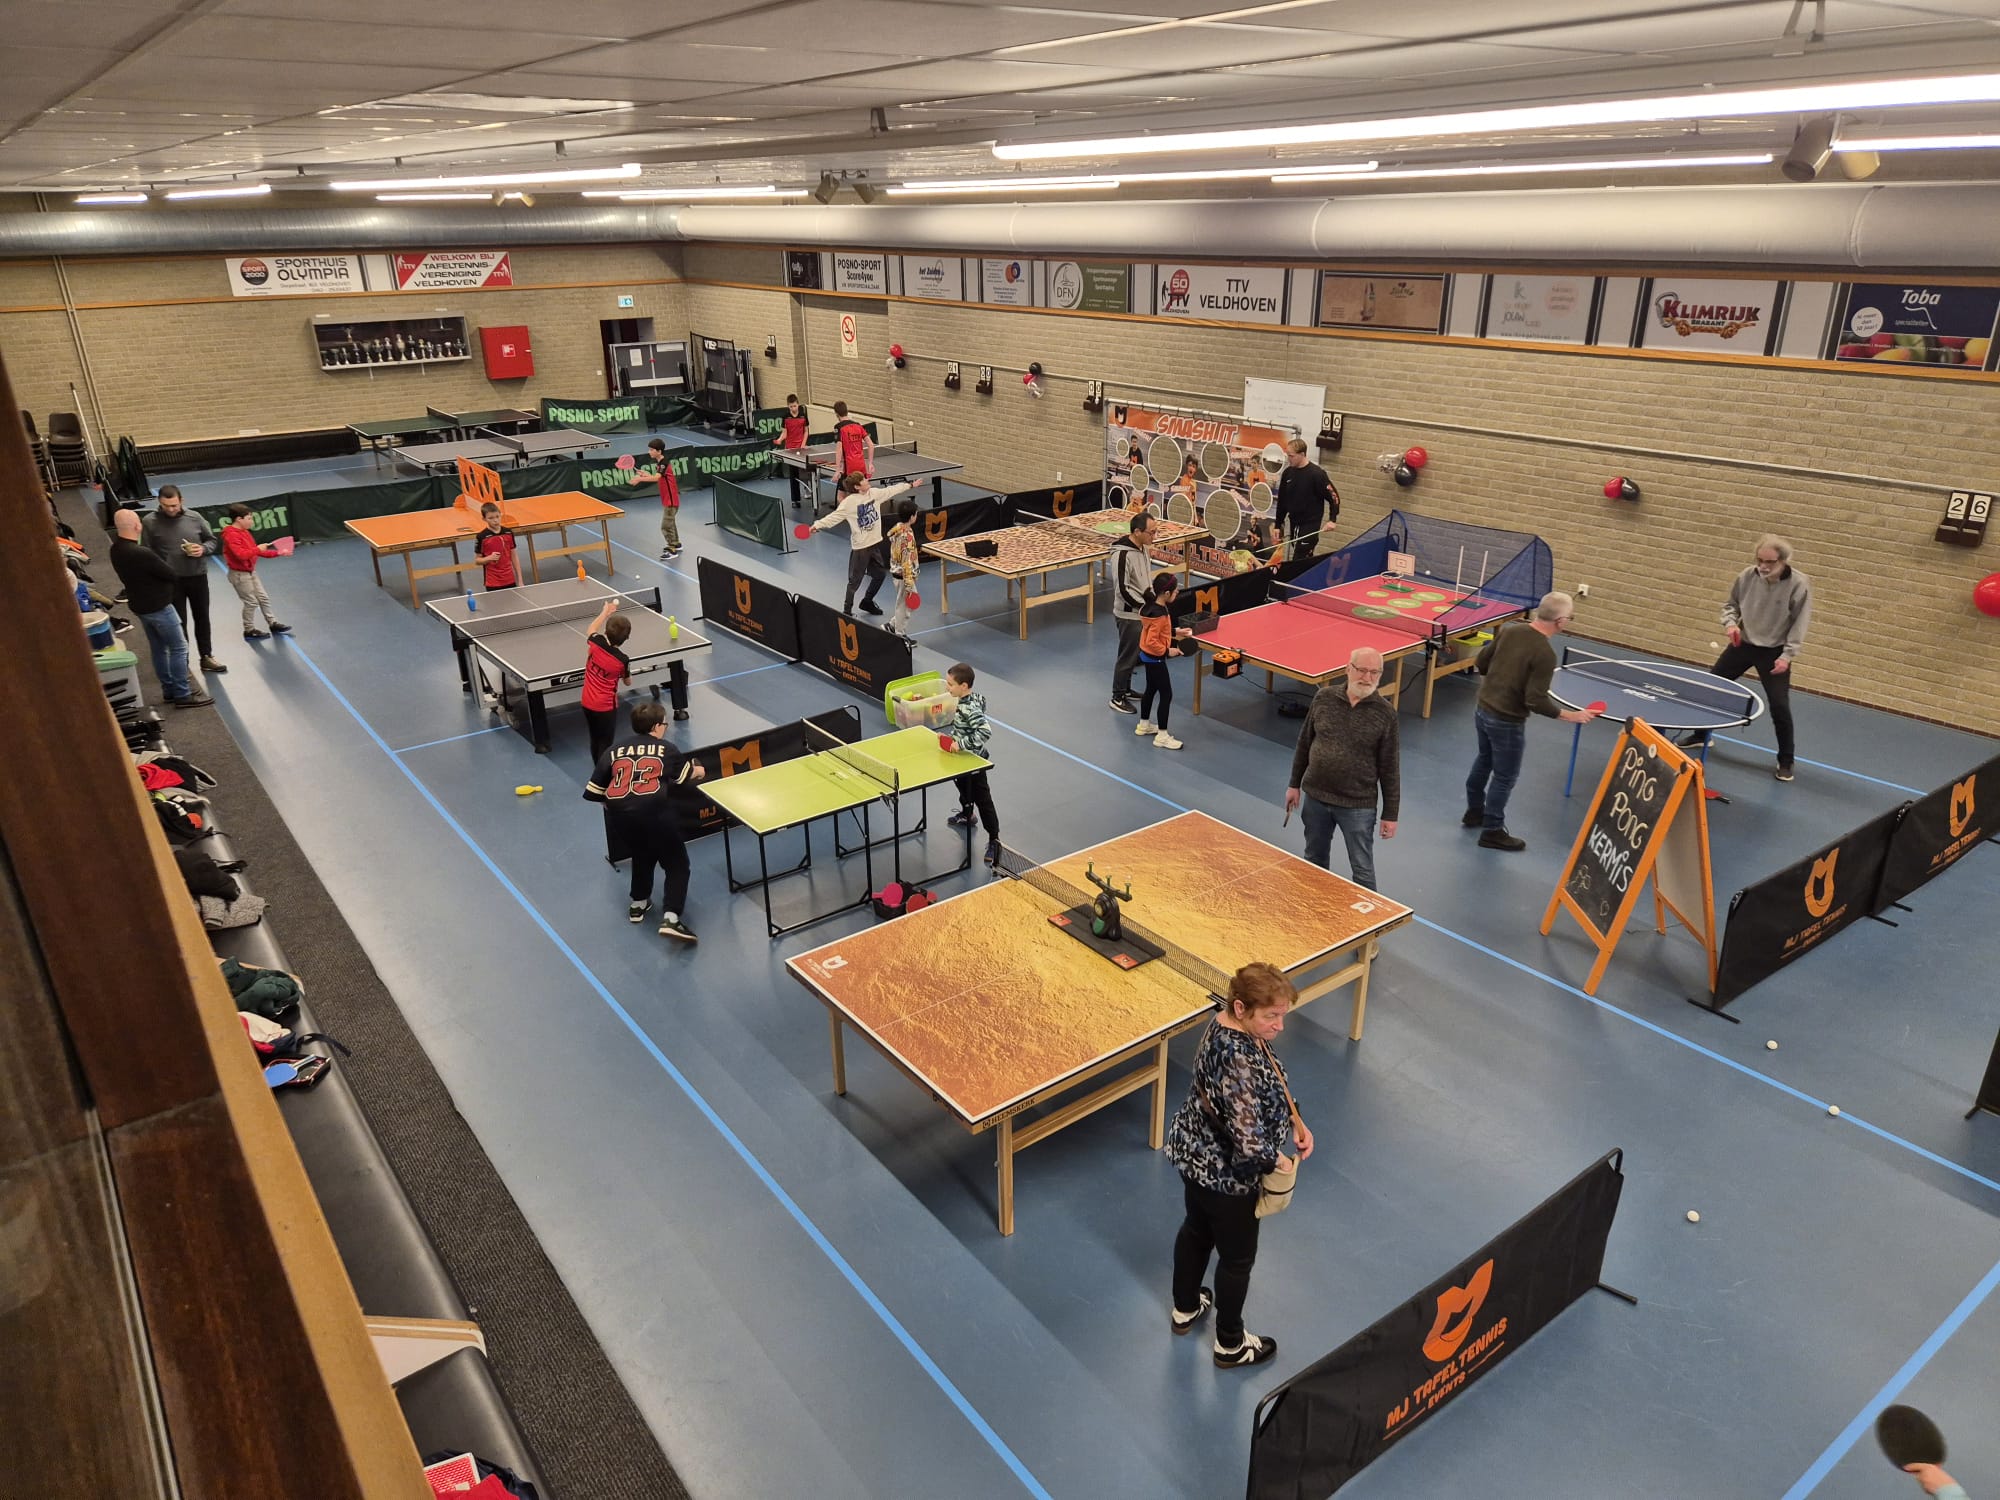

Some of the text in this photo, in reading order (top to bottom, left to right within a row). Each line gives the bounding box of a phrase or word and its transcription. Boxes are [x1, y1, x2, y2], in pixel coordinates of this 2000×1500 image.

[274, 257, 347, 269] SPORTHUIS
[430, 252, 495, 262] WELKOM BIJ
[837, 258, 882, 271] POSNO-SPORT
[241, 265, 266, 273] SPORT
[244, 271, 266, 279] 2000
[277, 267, 350, 281] OLYMPIA
[420, 270, 482, 279] VERENIGING
[846, 270, 874, 284] Score4you
[413, 279, 478, 288] VELDHOVEN
[1172, 278, 1188, 289] 50
[1225, 278, 1250, 294] TTV
[1056, 286, 1075, 299] DFN
[1168, 292, 1190, 308] TTV
[1900, 288, 1942, 306] Toba
[1199, 294, 1277, 313] VELDHOVEN
[1662, 298, 1761, 322] KLIMRIJK
[548, 405, 640, 424] POSNO-SPORT
[1156, 414, 1222, 444] SMASH
[695, 450, 780, 475] POSNO-SPO
[580, 456, 689, 489] POSNOSPRT
[606, 755, 664, 800] 03
[700, 805, 717, 819] MJ
[991, 1097, 1036, 1125] HEEMSKERK
[1427, 1370, 1467, 1409] EVENTS
[1386, 1396, 1410, 1430] MJ
